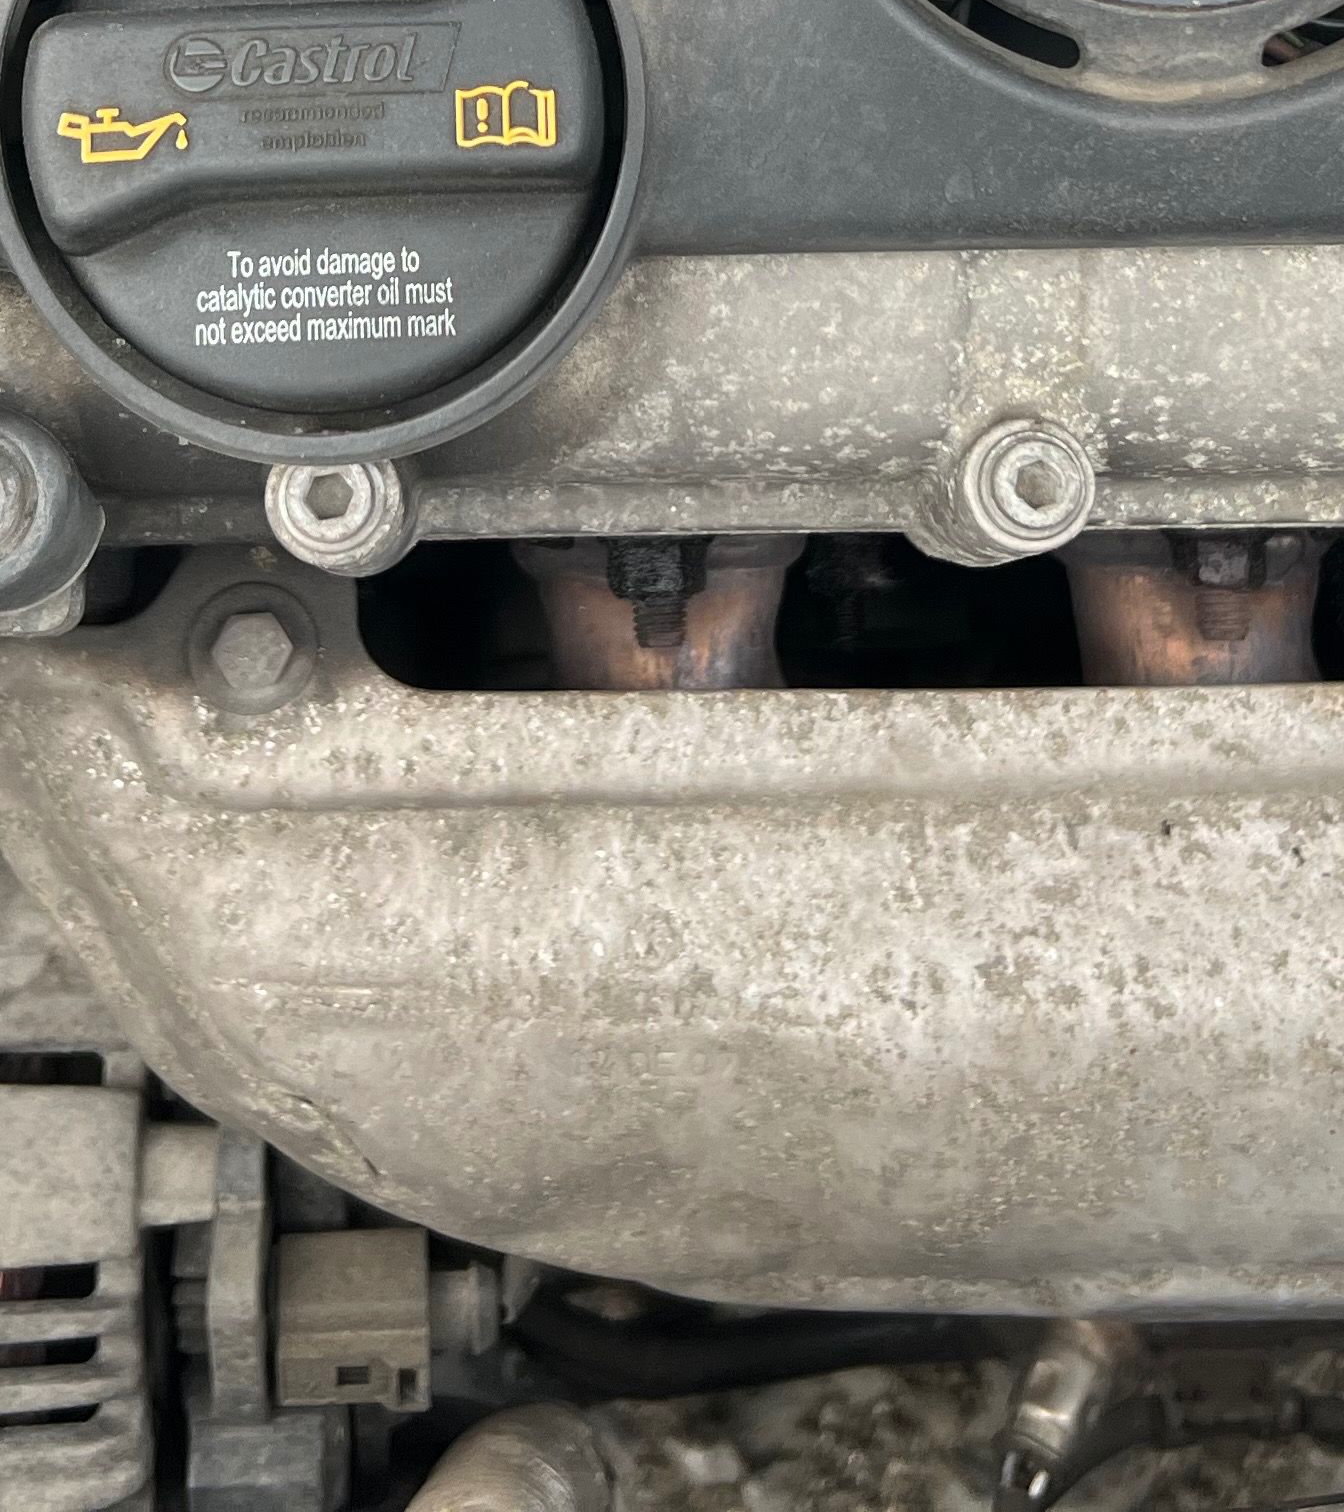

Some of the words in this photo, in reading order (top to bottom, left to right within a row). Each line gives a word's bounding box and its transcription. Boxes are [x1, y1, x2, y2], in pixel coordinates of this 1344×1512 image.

[231, 31, 419, 87] Castrol
[227, 250, 254, 278] To
[258, 248, 311, 277] avoid
[316, 247, 396, 280] damage
[400, 246, 420, 273] to
[196, 281, 277, 318] catalytic
[280, 279, 373, 309] converter
[377, 276, 400, 305] oil
[405, 277, 454, 305] must
[195, 317, 227, 346] not
[231, 313, 302, 345] exceed
[307, 311, 402, 341] maximum
[407, 308, 457, 337] mark
